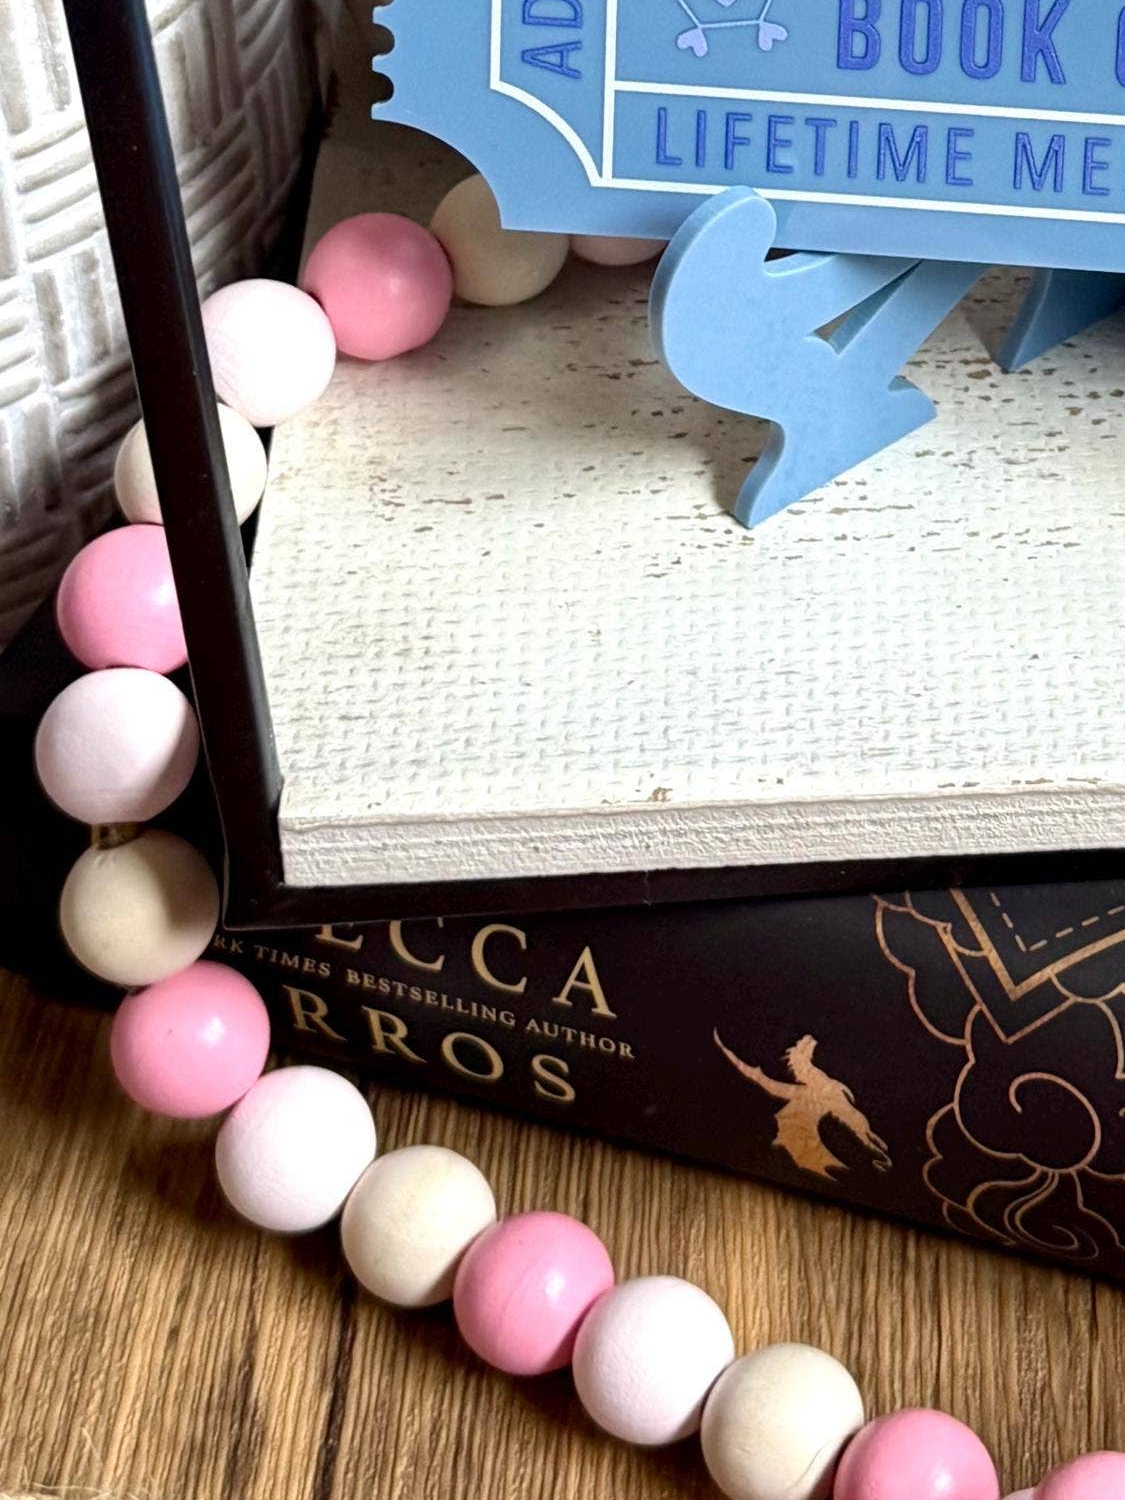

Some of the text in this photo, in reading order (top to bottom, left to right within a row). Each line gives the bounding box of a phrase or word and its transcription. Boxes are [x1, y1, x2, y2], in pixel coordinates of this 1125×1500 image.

[655, 106, 975, 188] LIFETIME
[254, 944, 331, 978] TIMES
[346, 968, 516, 1026] BESTSELLING
[526, 1017, 636, 1060] AUTHOR
